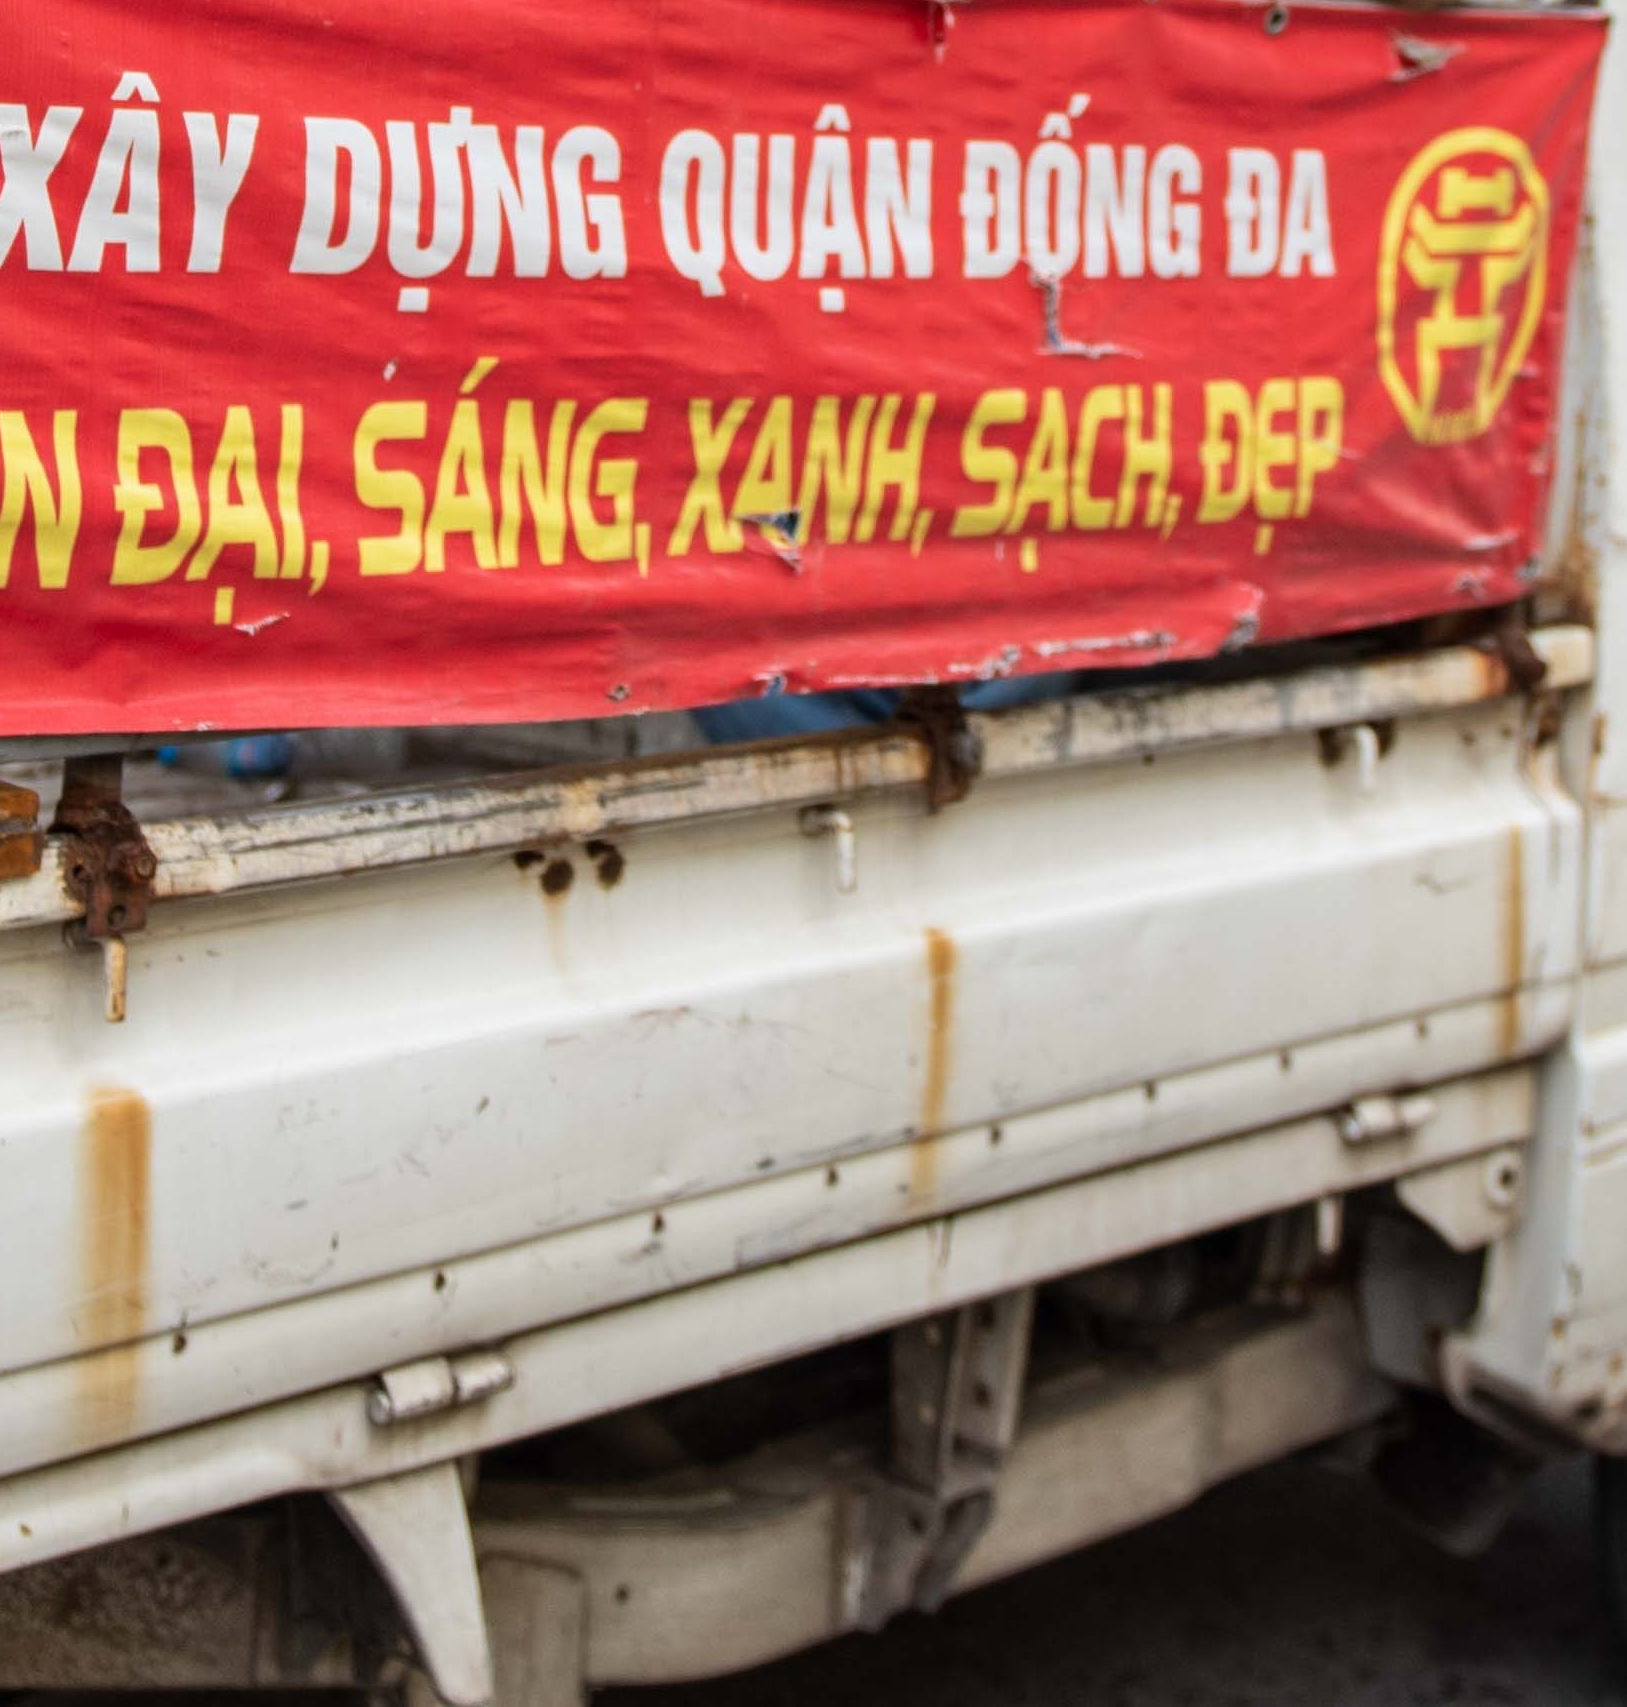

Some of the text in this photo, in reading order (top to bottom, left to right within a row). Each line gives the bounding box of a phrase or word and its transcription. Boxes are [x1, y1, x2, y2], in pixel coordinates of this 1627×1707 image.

[291, 108, 625, 311] DỰNG
[661, 106, 931, 311] QUẬN
[960, 94, 1201, 278] ĐỐNG
[1227, 150, 1333, 276] ĐA
[112, 404, 329, 623] ĐẠI,
[354, 357, 650, 575] SÁNG,
[668, 393, 935, 556] XANH,
[954, 383, 1180, 572] SẠCH,
[1200, 377, 1343, 554] ĐẸP
